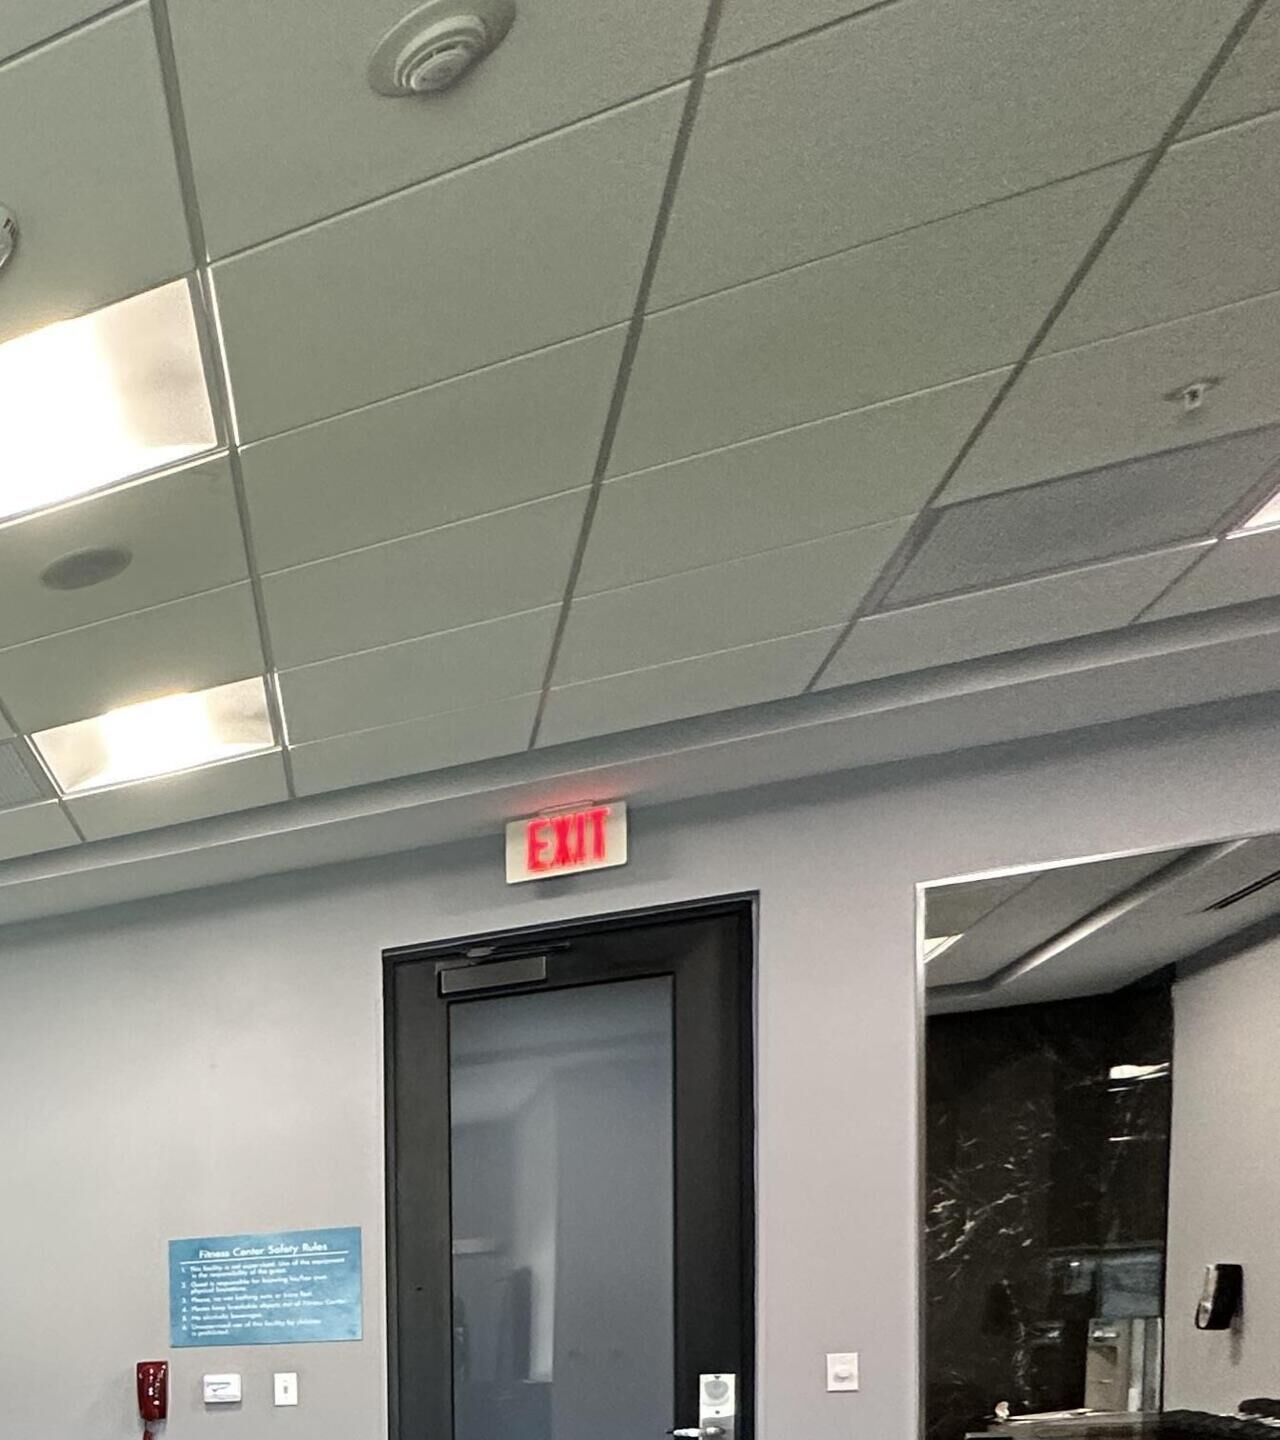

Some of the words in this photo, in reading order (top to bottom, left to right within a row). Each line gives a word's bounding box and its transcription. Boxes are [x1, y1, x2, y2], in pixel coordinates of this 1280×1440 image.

[526, 807, 610, 872] EXIT
[199, 1249, 229, 1258] Fitness
[233, 1247, 264, 1256] Center
[268, 1244, 298, 1256] Safety
[302, 1241, 327, 1251] Rules
